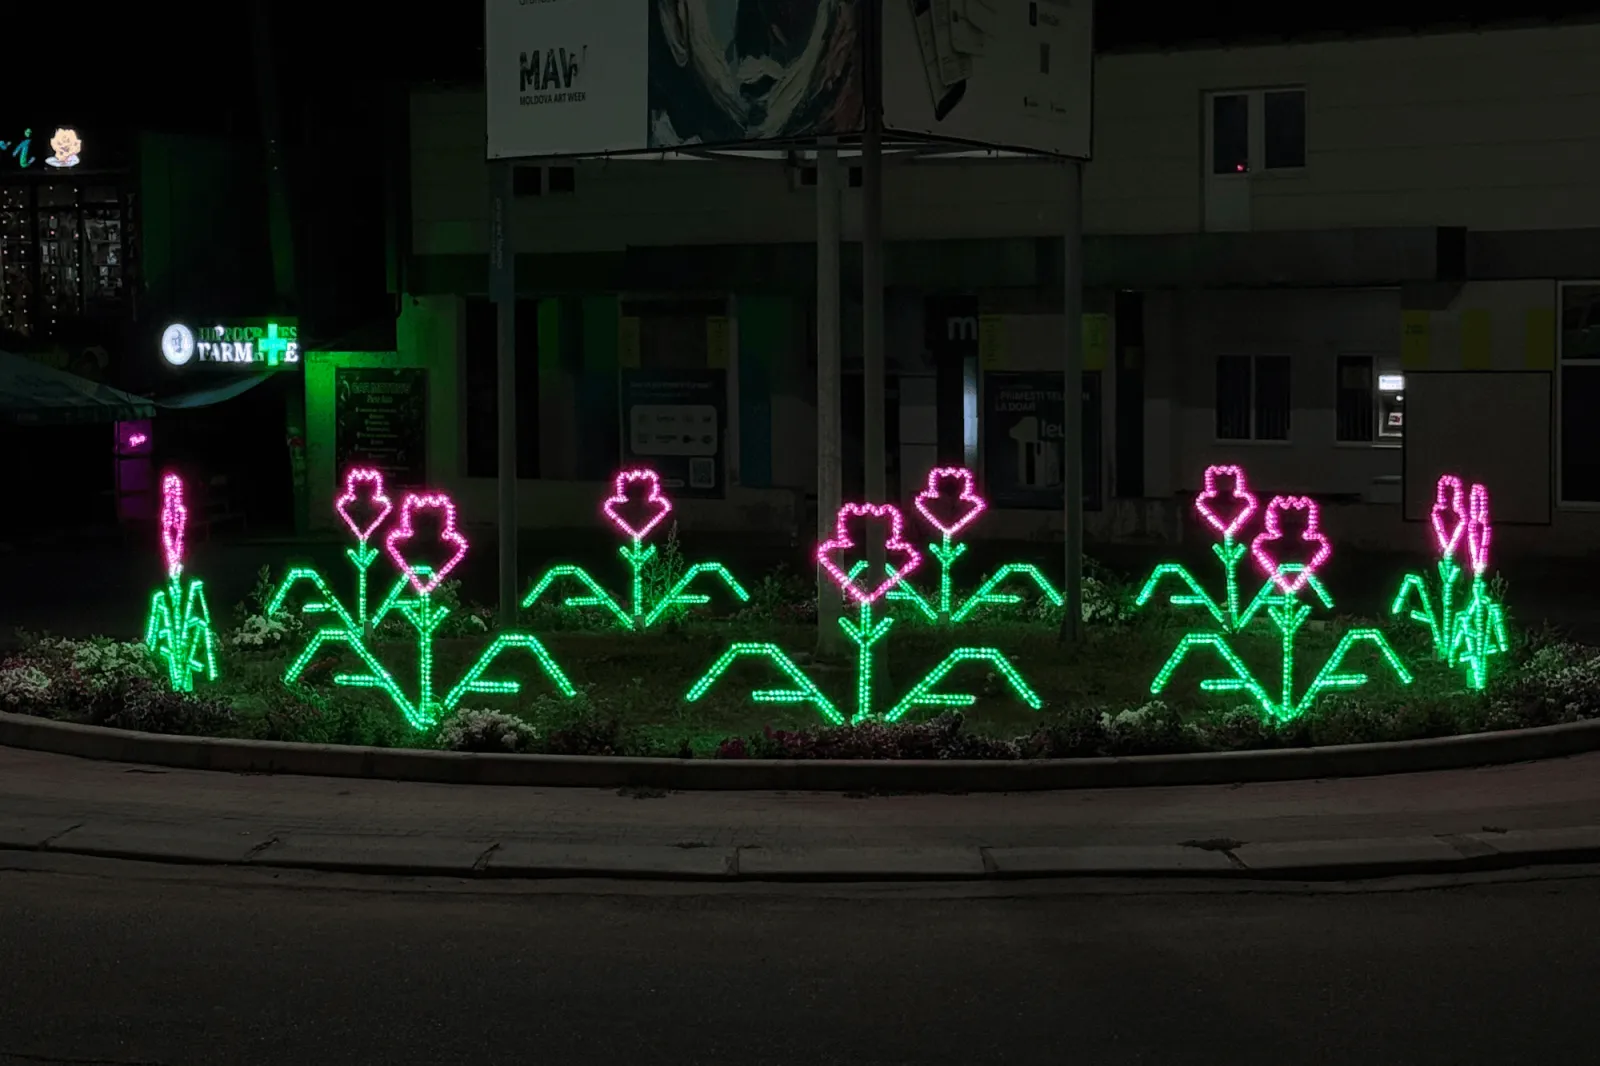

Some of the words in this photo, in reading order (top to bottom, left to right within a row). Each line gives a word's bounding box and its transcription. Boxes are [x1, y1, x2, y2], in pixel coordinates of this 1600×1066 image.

[519, 94, 552, 105] MOLDOVA
[553, 92, 566, 104] ART
[567, 92, 586, 103] WEEK
[199, 326, 297, 341] HIPPOCRES
[197, 342, 299, 362] FARME
